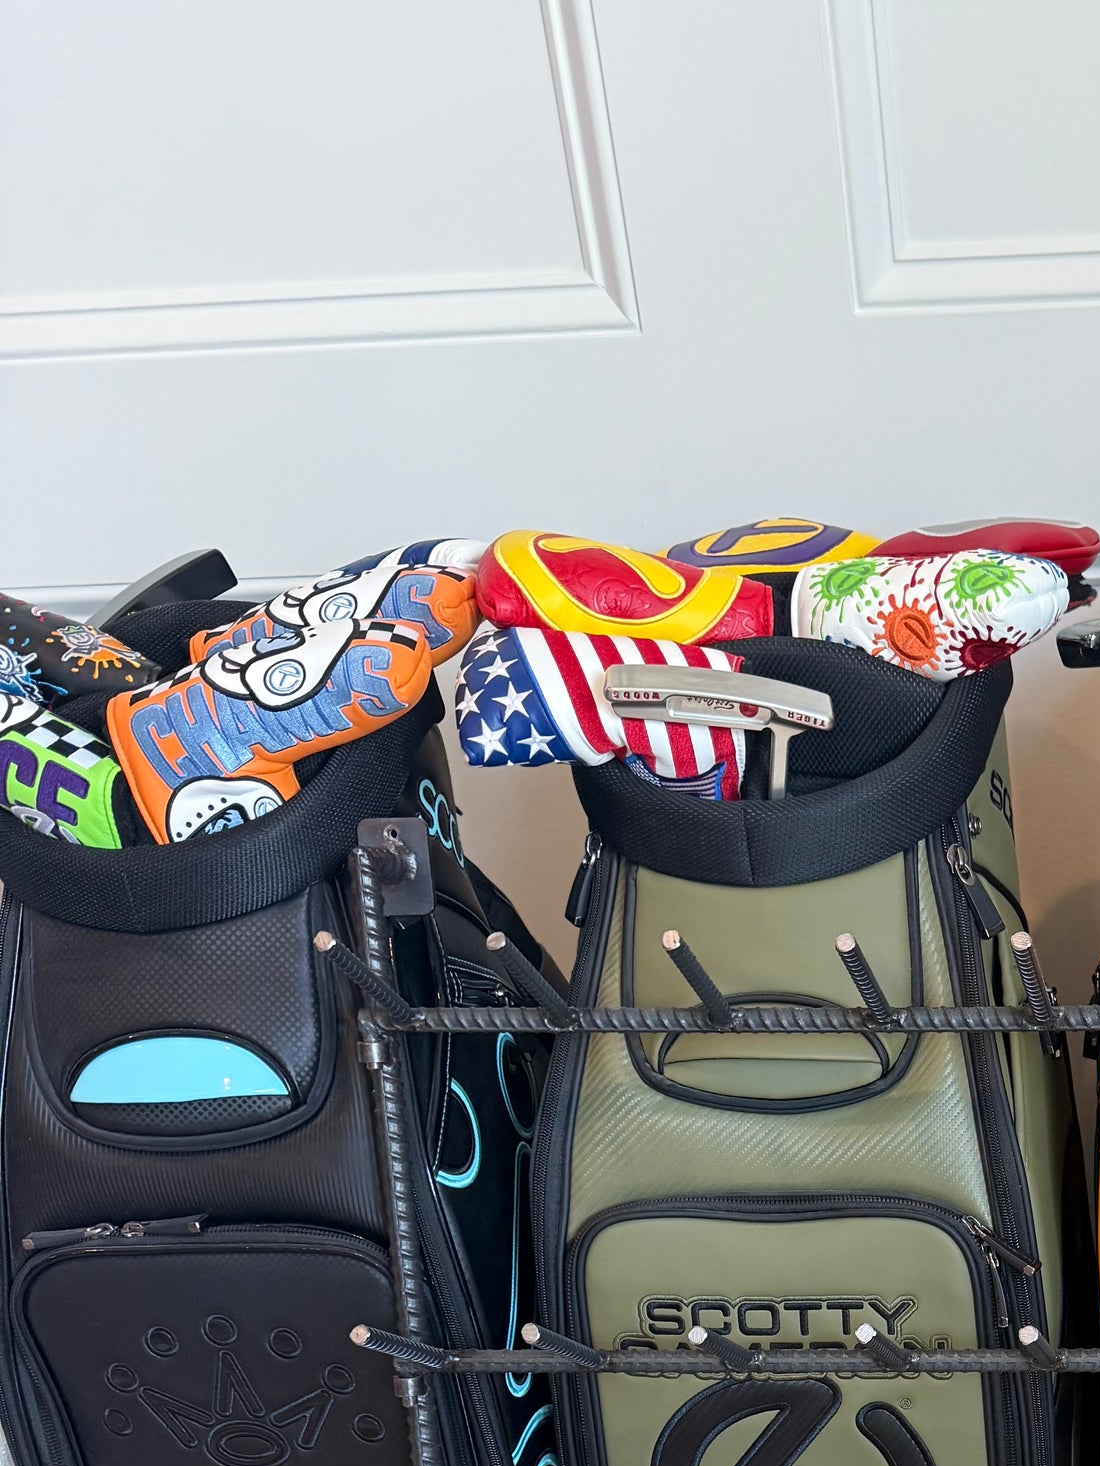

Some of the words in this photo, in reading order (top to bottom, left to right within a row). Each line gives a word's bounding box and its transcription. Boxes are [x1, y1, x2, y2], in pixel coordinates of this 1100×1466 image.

[612, 690, 661, 700] WOODS
[787, 711, 827, 729] TIGER
[646, 1301, 914, 1337] SCOTTY
